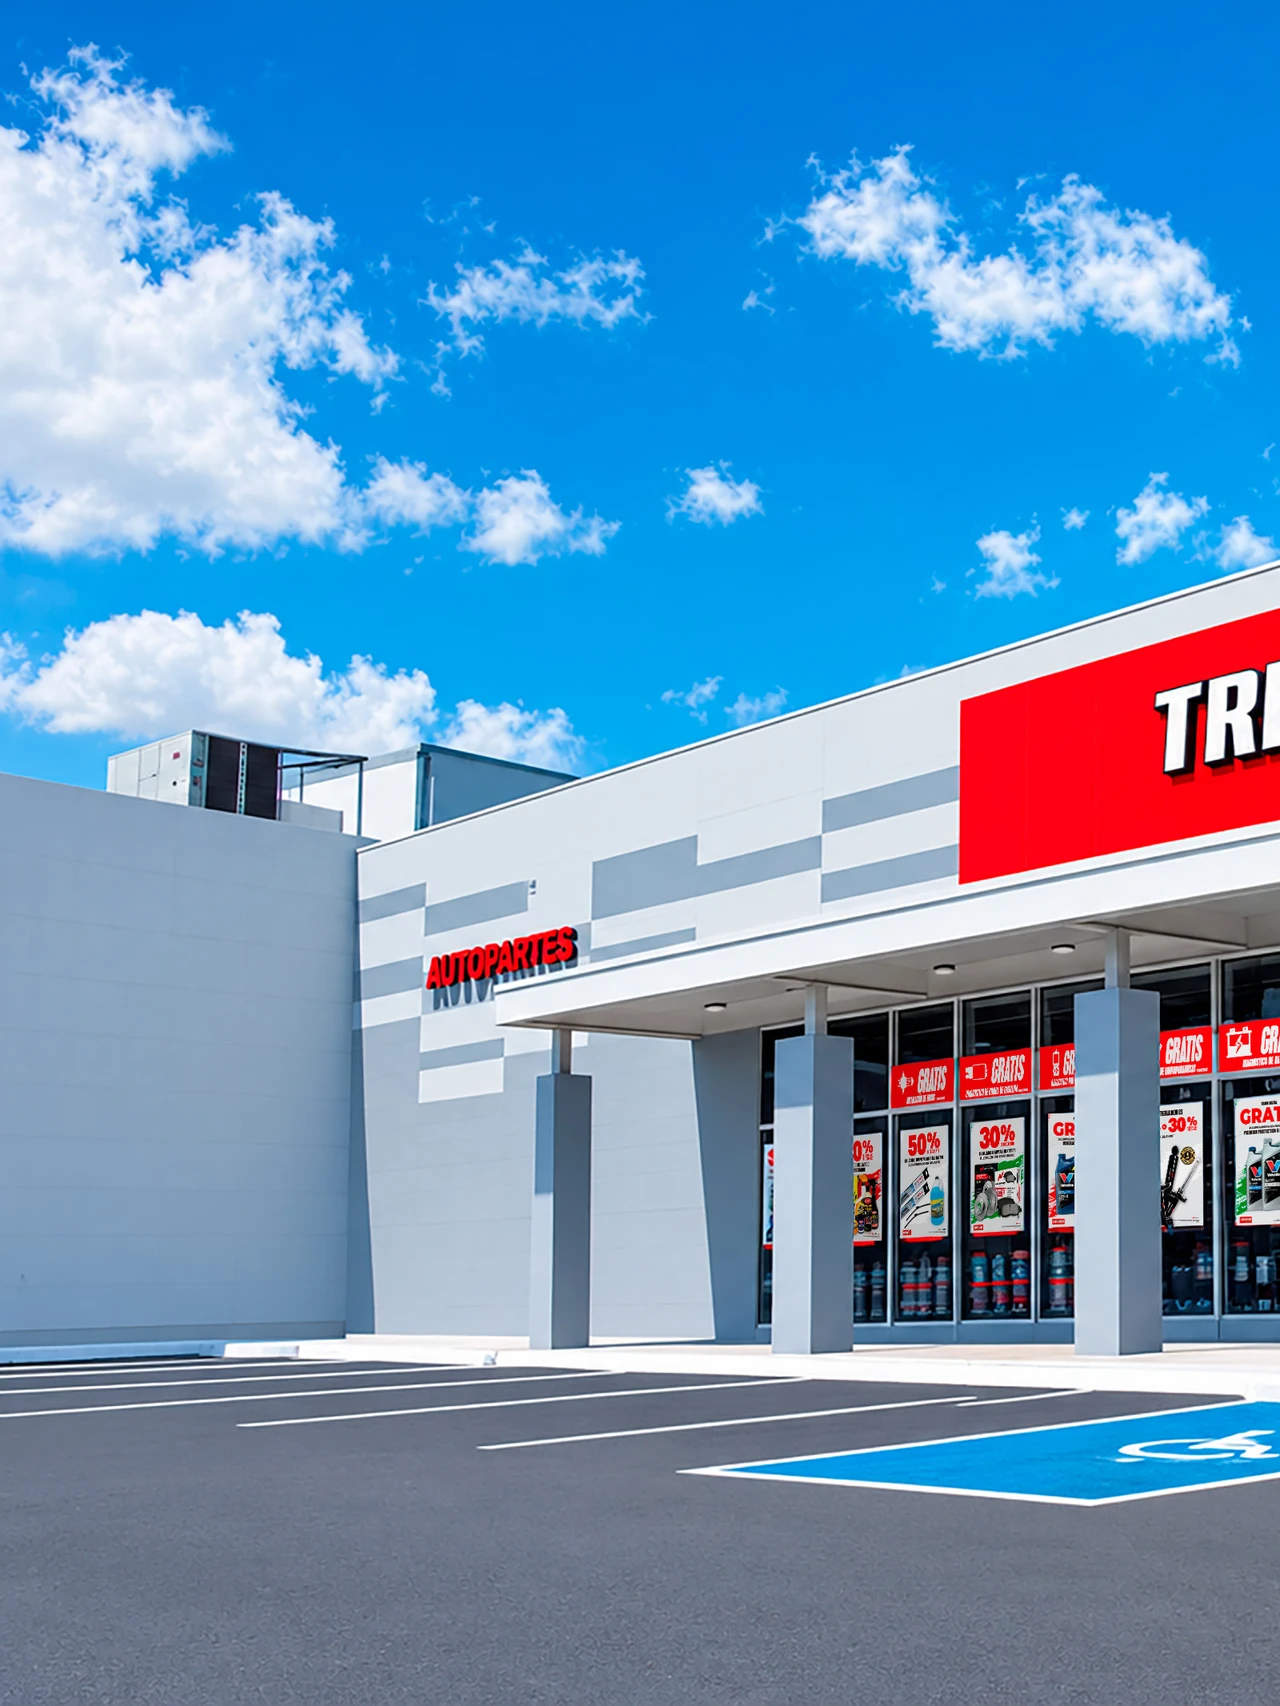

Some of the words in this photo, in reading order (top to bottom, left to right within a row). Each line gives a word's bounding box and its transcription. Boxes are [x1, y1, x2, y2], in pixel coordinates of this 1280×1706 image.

[425, 926, 578, 991] AUTOPARTES
[1165, 1034, 1204, 1064] GRATIS
[917, 1065, 948, 1093] GRATIS
[991, 1054, 1026, 1084] GRATIS
[979, 1124, 1015, 1149] 30%
[1168, 1116, 1198, 1132] 30%
[908, 1132, 941, 1156] 50%
